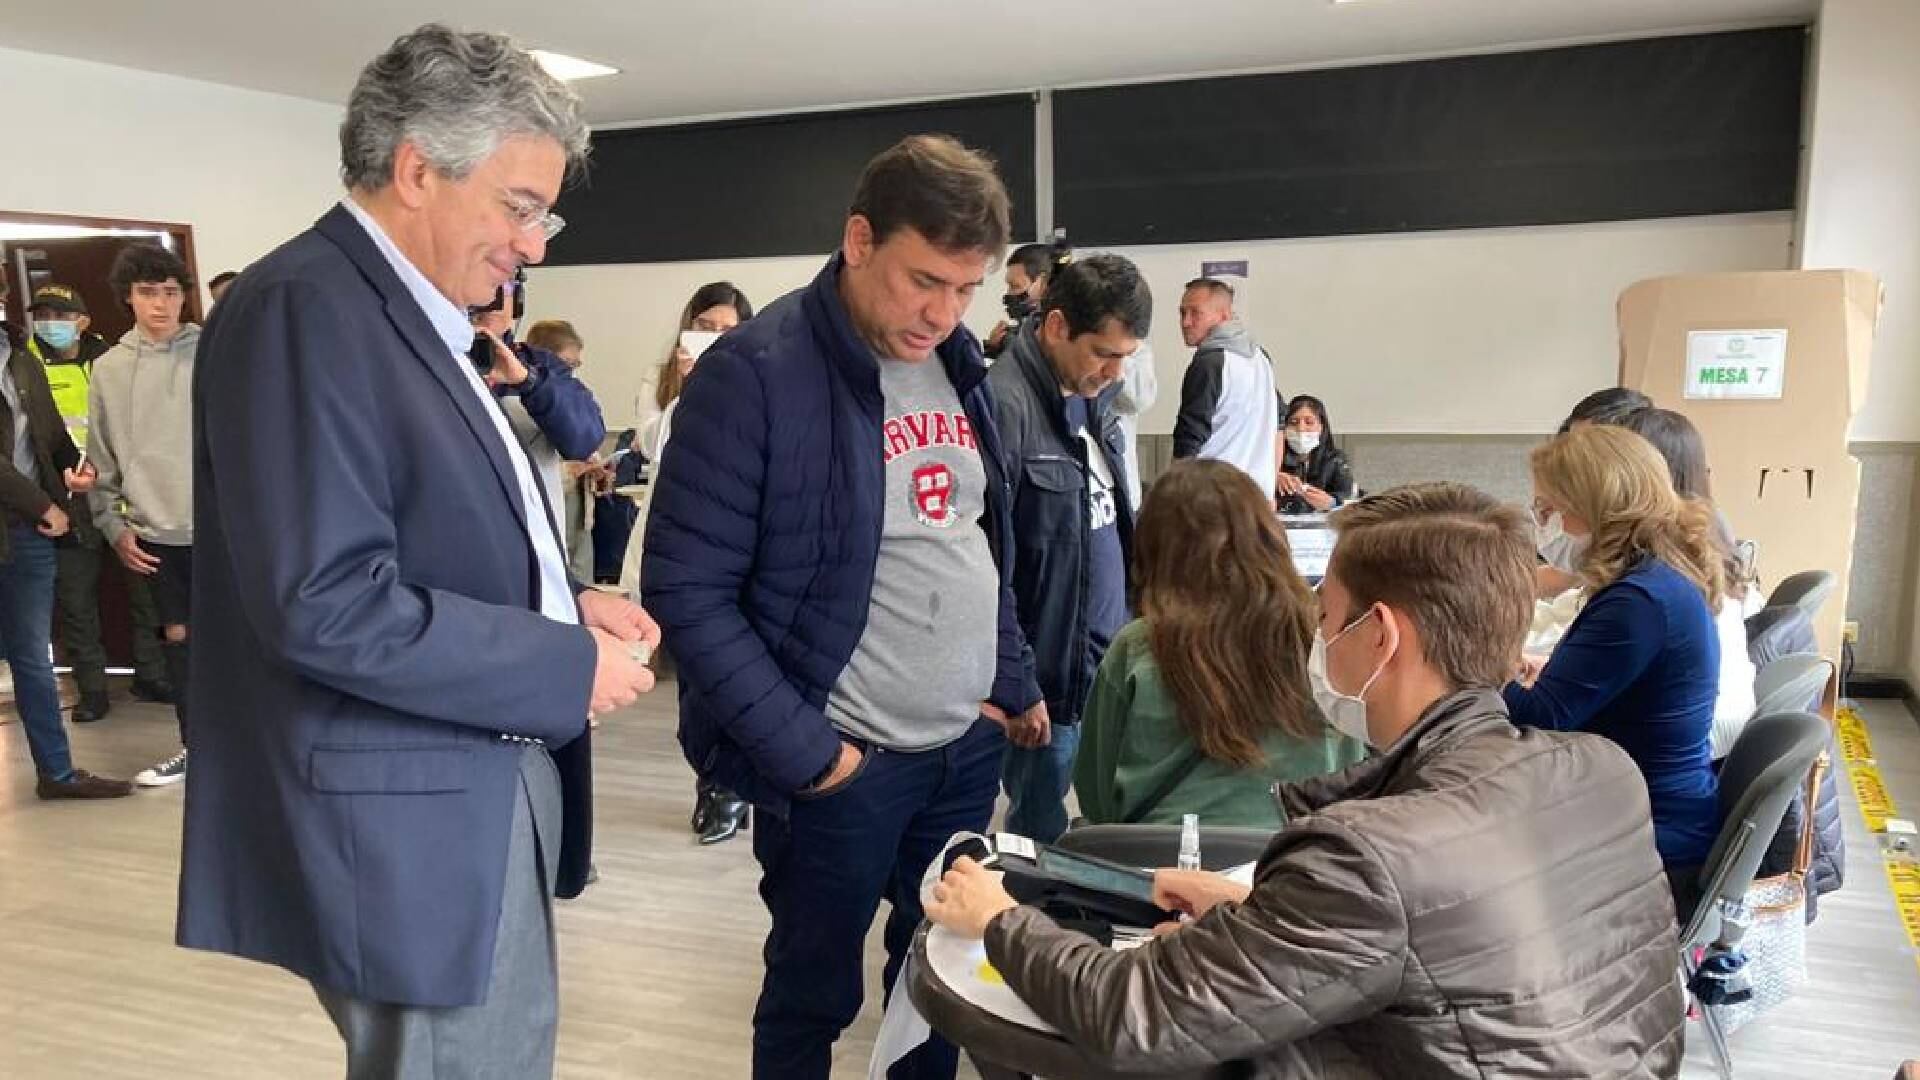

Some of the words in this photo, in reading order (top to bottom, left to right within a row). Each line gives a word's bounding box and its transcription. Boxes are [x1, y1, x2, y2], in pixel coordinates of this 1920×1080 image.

[1698, 366, 1749, 385] MESA
[1755, 366, 1769, 385] 7
[884, 411, 979, 463] RVAR
